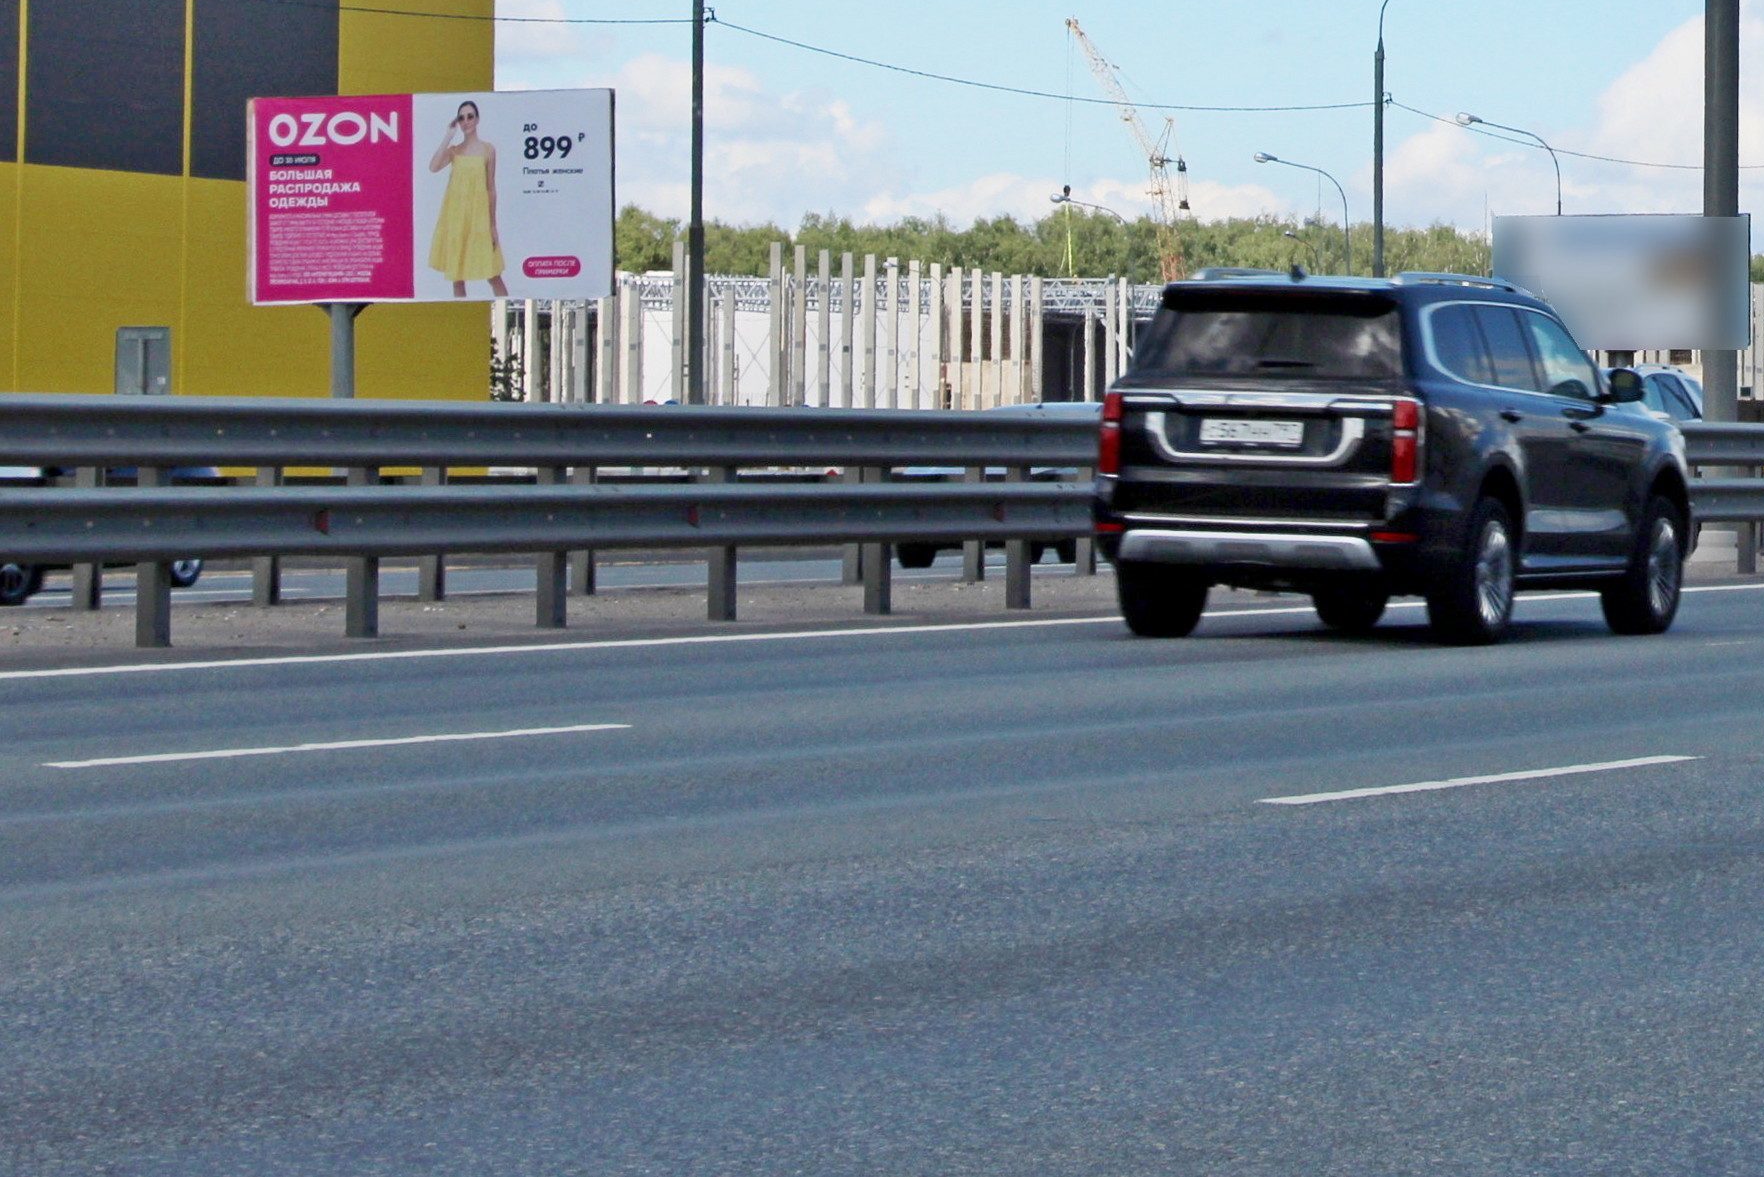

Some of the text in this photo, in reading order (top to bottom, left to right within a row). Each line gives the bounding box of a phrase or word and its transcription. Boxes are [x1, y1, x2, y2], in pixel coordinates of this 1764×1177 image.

[269, 111, 398, 147] OZON
[523, 123, 538, 133] до
[524, 136, 572, 159] 899
[269, 170, 333, 181] БОЛЬШАЯ
[269, 183, 360, 194] РАСПРОДАЖА
[269, 197, 328, 208] ОДЕЖДЫ
